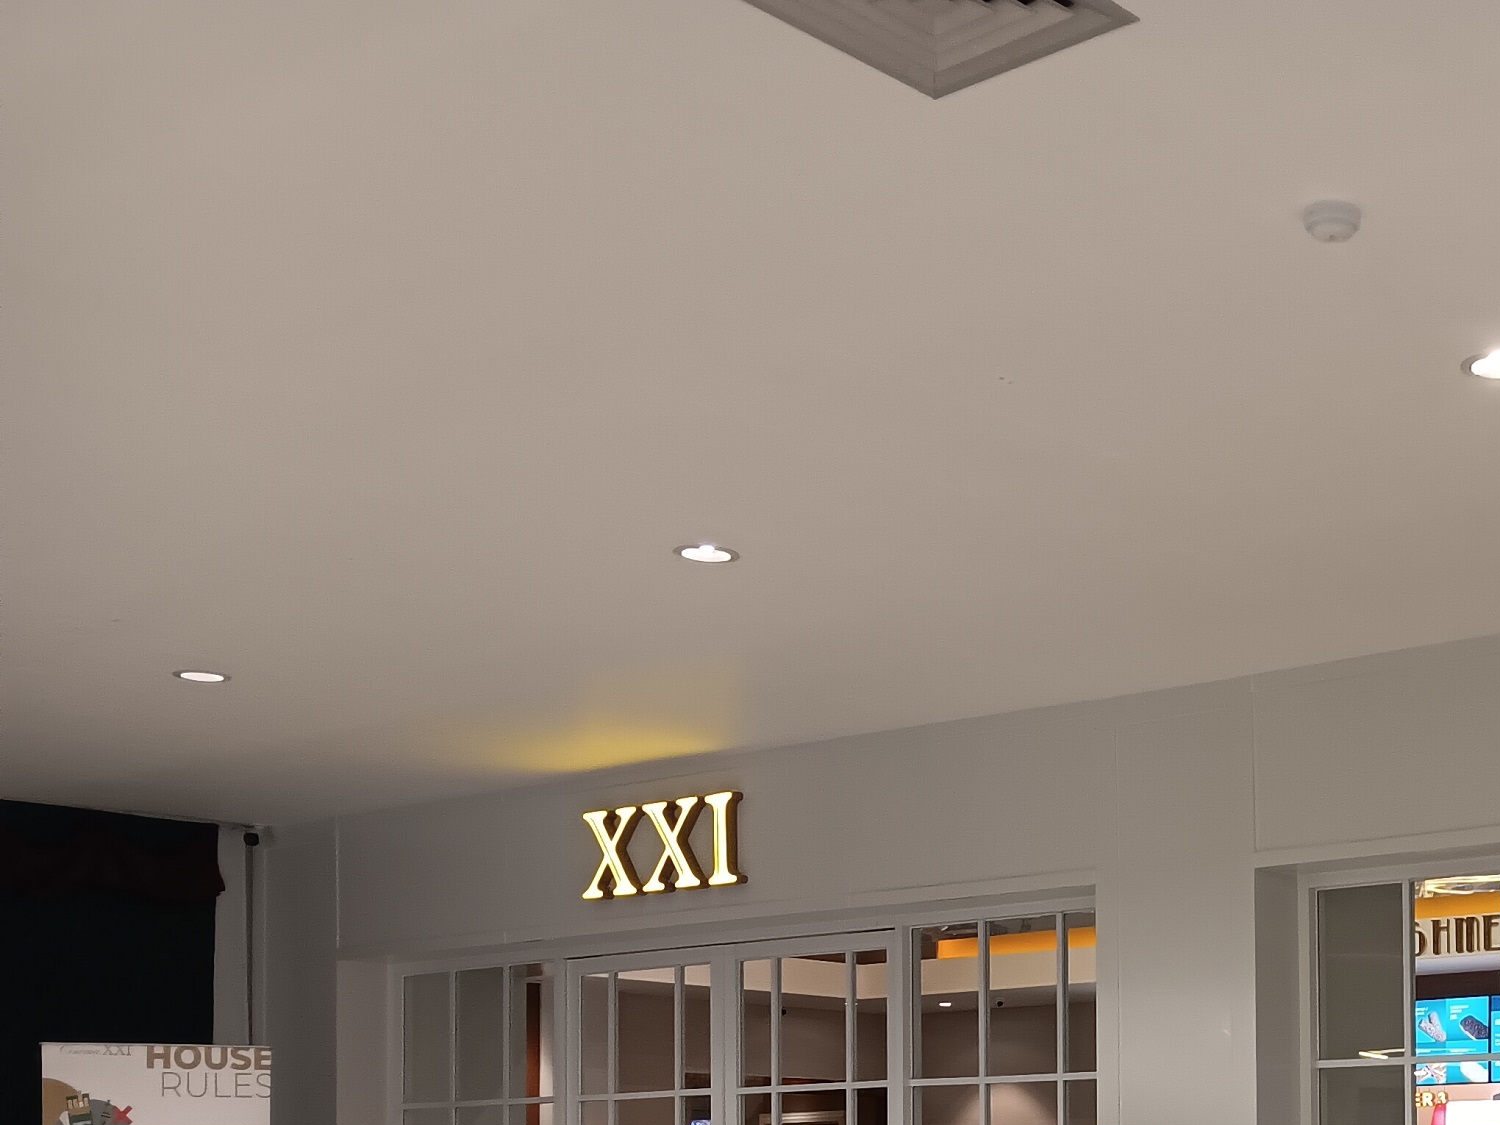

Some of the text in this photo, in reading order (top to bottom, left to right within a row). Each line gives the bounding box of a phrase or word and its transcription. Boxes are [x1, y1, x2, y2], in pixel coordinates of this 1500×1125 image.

[582, 791, 746, 900] XXI
[146, 1046, 272, 1071] HOUSE
[162, 1072, 272, 1098] RULES
